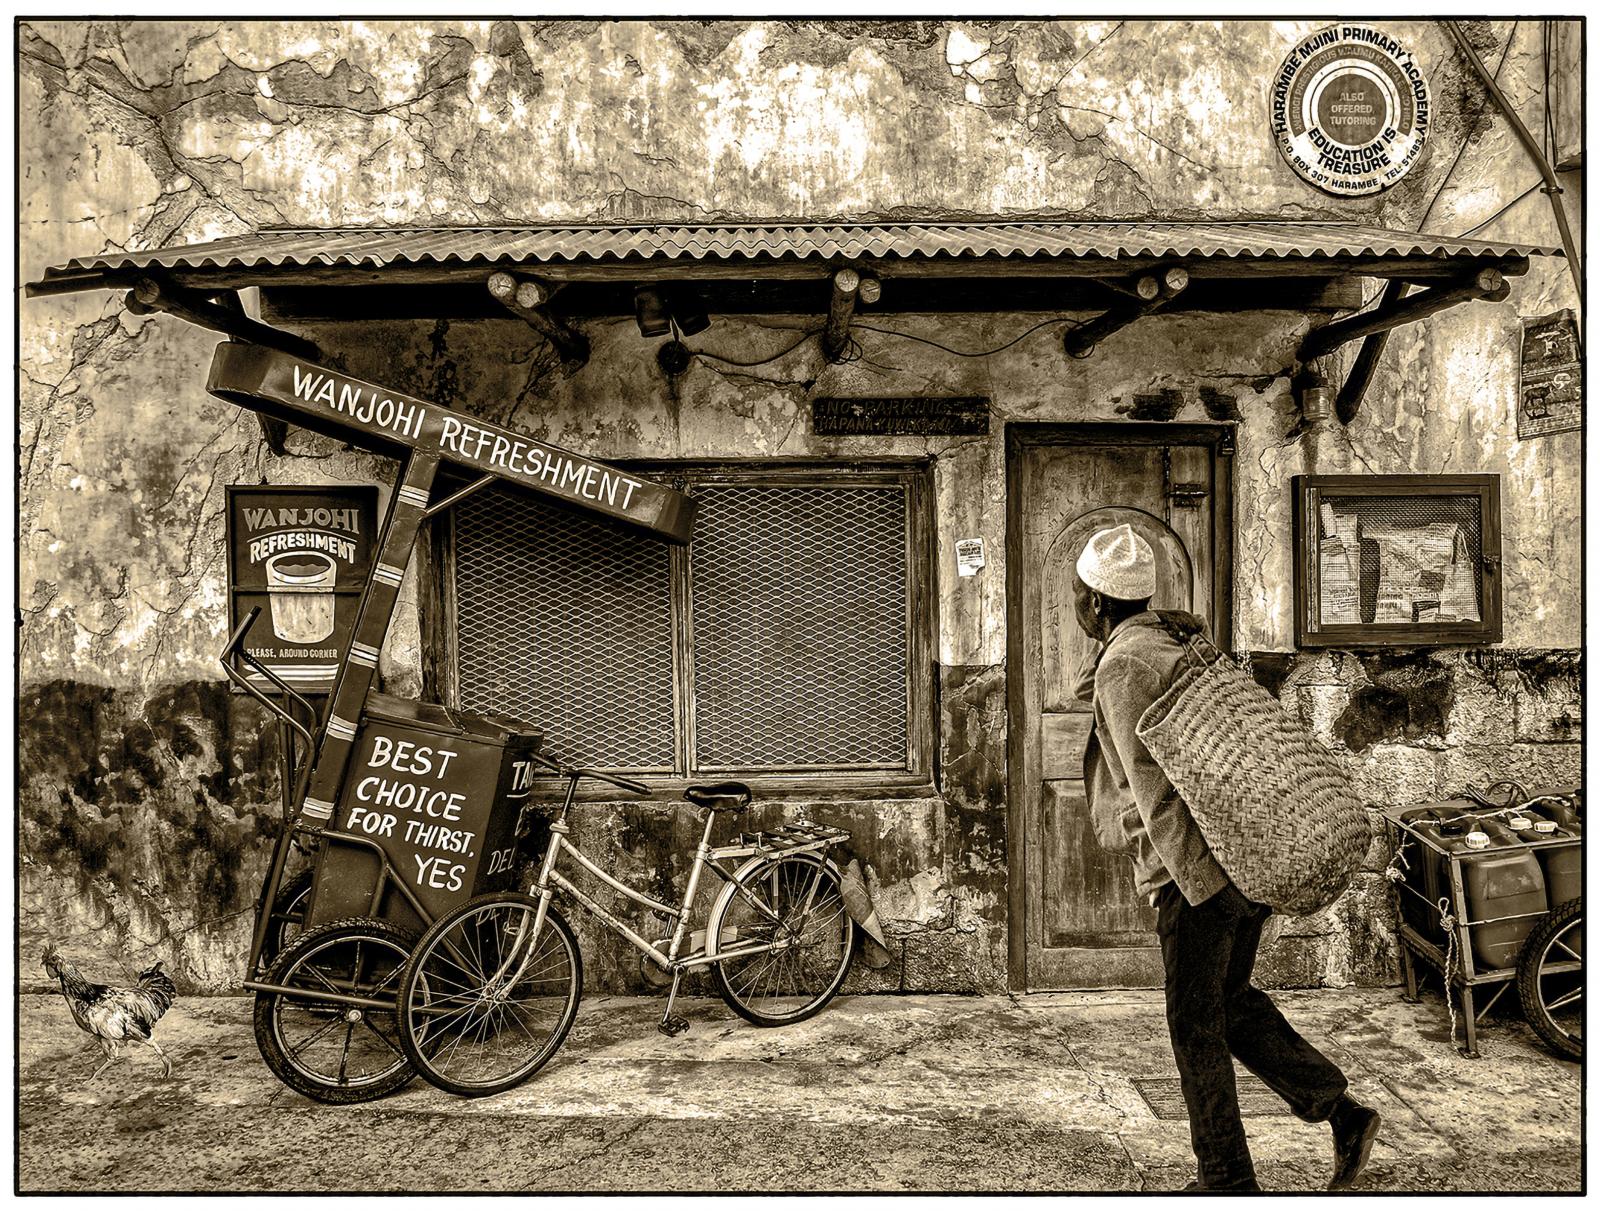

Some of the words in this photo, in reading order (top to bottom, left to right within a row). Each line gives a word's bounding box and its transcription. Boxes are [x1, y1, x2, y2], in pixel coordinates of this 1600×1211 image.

[1274, 56, 1302, 133] HARAMBE
[1301, 29, 1339, 59] MJINI
[1343, 27, 1406, 60] PRIMARY
[1401, 61, 1429, 134] ACADEMY
[1295, 50, 1337, 96] PRESTIGIOUS
[1331, 104, 1373, 113] OFFERED
[1340, 92, 1365, 101] ALSO
[1329, 116, 1377, 126] TUTORING
[1307, 126, 1384, 163] EDUCATION
[1381, 127, 1397, 144] IS
[1317, 152, 1391, 175] TREASURE
[1292, 155, 1311, 173] BOX
[1311, 170, 1330, 184] 307
[1331, 178, 1379, 190] HARAMBE
[1401, 138, 1423, 167] 51483
[293, 365, 426, 439] WANJOHI
[439, 416, 642, 510] REFRESHMENT
[242, 508, 360, 535] WANJOHI
[250, 532, 356, 564] REFRESHMENT
[246, 648, 277, 659] PLEASE,
[279, 648, 309, 659] AROUND
[309, 649, 338, 659] CORNER
[367, 736, 458, 780] BEST
[356, 776, 466, 821] CHOICE
[346, 808, 397, 838] FOR
[403, 820, 476, 858] THIRST,
[413, 853, 466, 892] YES
